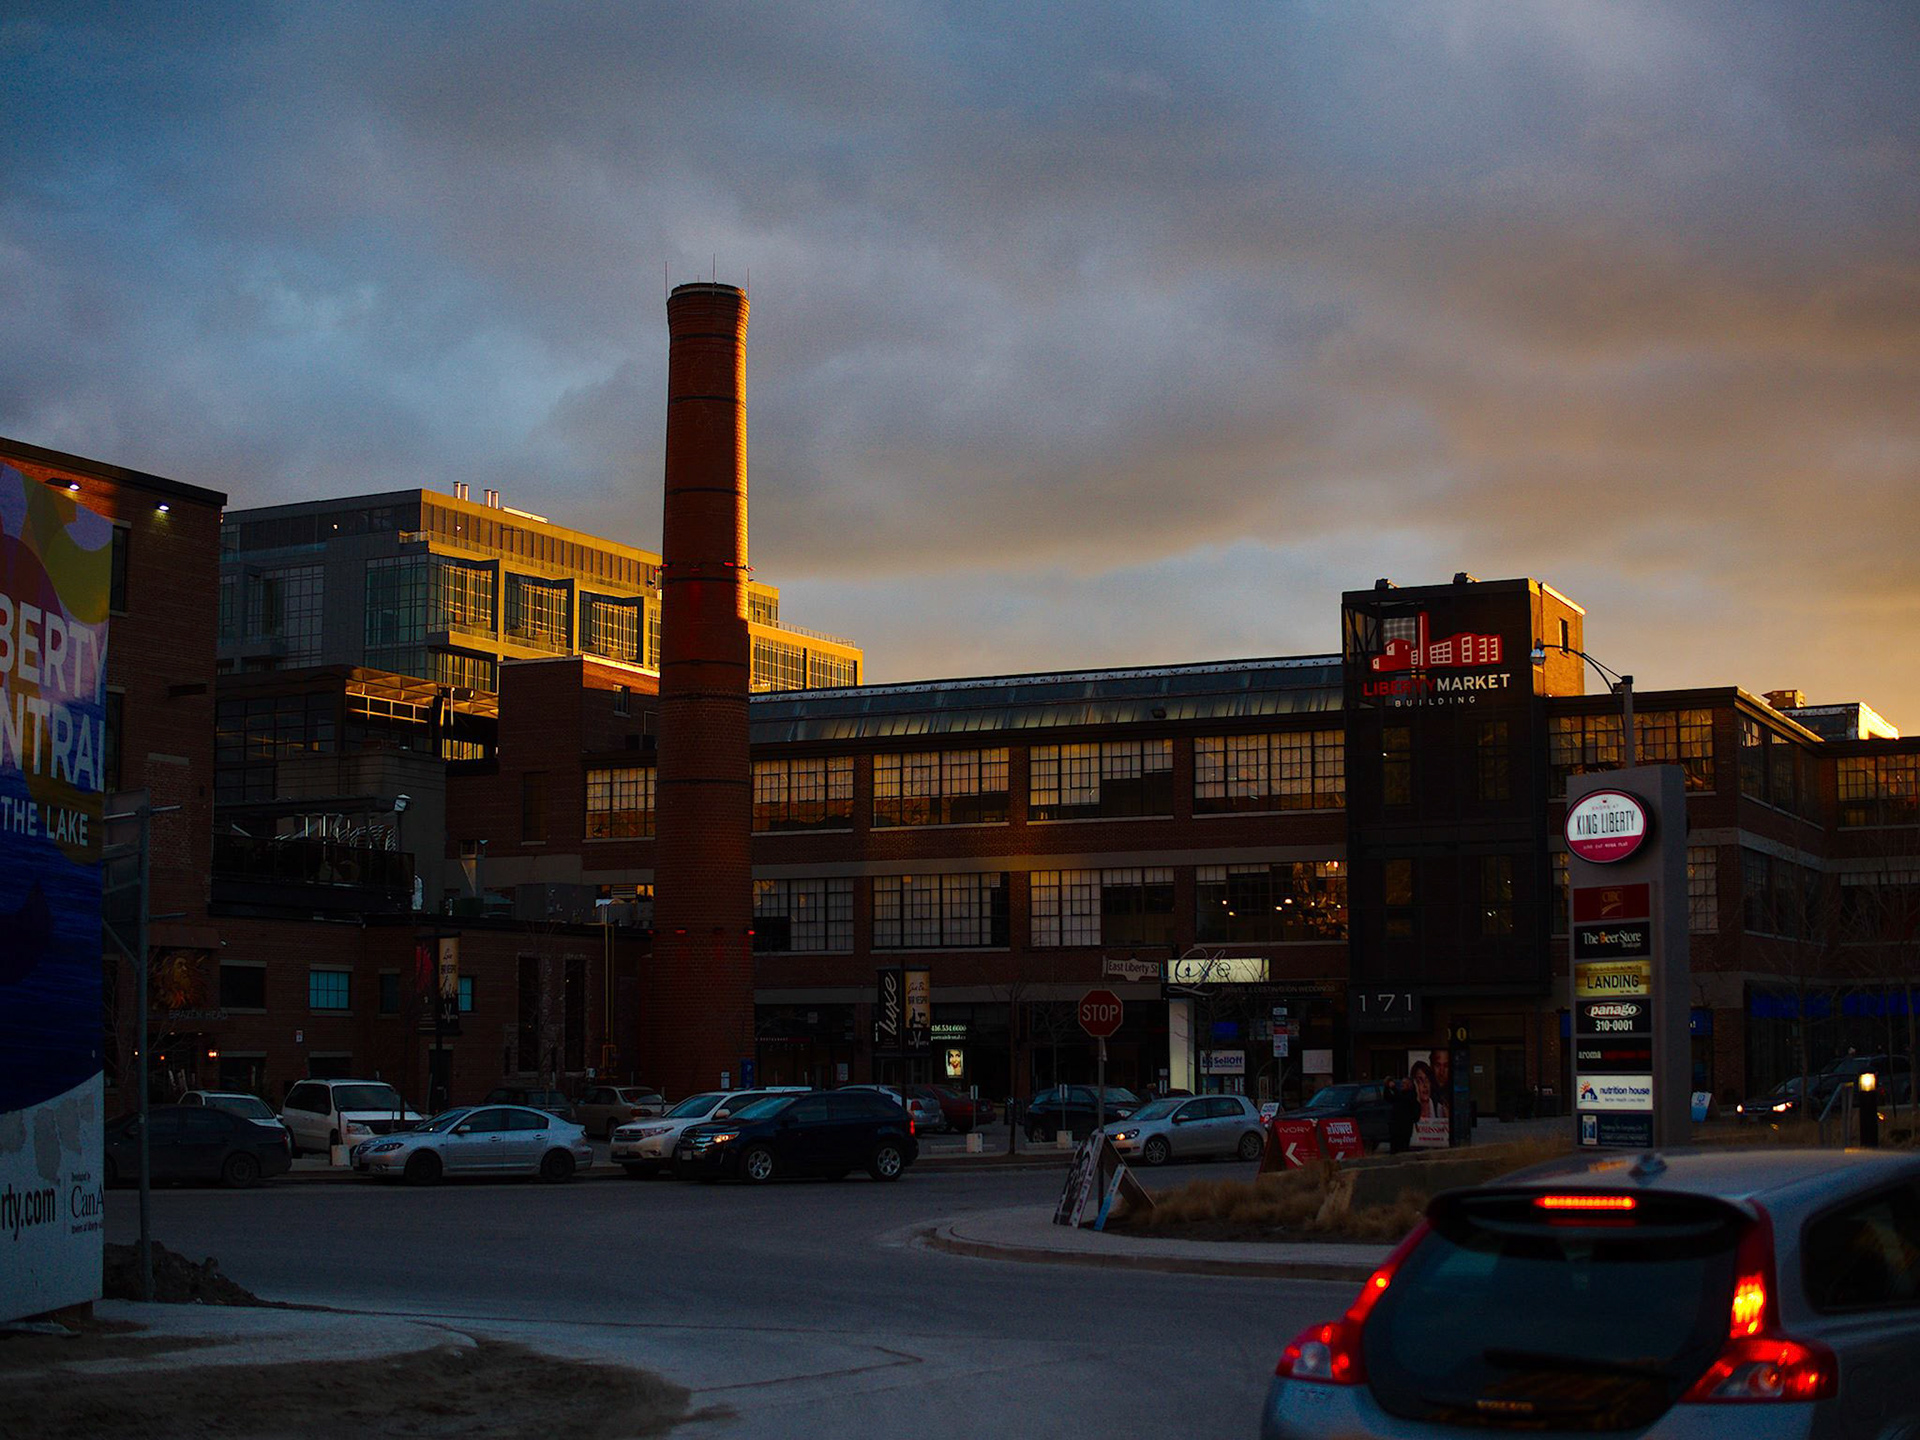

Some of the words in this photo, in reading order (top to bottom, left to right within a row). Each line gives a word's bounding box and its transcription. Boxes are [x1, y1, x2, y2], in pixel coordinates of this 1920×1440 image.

[1364, 679, 1437, 696] LIBERTY
[1437, 673, 1511, 692] MARKET
[1395, 695, 1476, 707] BUILDING
[0, 795, 37, 836] THE
[46, 805, 89, 847] LAKE
[1577, 814, 1597, 835] KING
[1601, 811, 1635, 833] LIBERTY
[1582, 932, 1598, 945] The
[1599, 931, 1618, 944] Beer
[1619, 929, 1642, 943] Store
[1109, 961, 1124, 973] East
[1125, 961, 1149, 975] Liberty
[1151, 962, 1158, 973] St
[1587, 974, 1639, 989] LANDING
[1358, 994, 1411, 1012] 171
[1590, 1003, 1637, 1017] panago
[1082, 1004, 1119, 1022] STOP
[1595, 1020, 1633, 1031] 310-0001
[1600, 1086, 1627, 1095] nutrition
[1629, 1086, 1650, 1095] house
[1279, 1126, 1310, 1134] IVORY
[2, 1184, 55, 1241] rty.com
